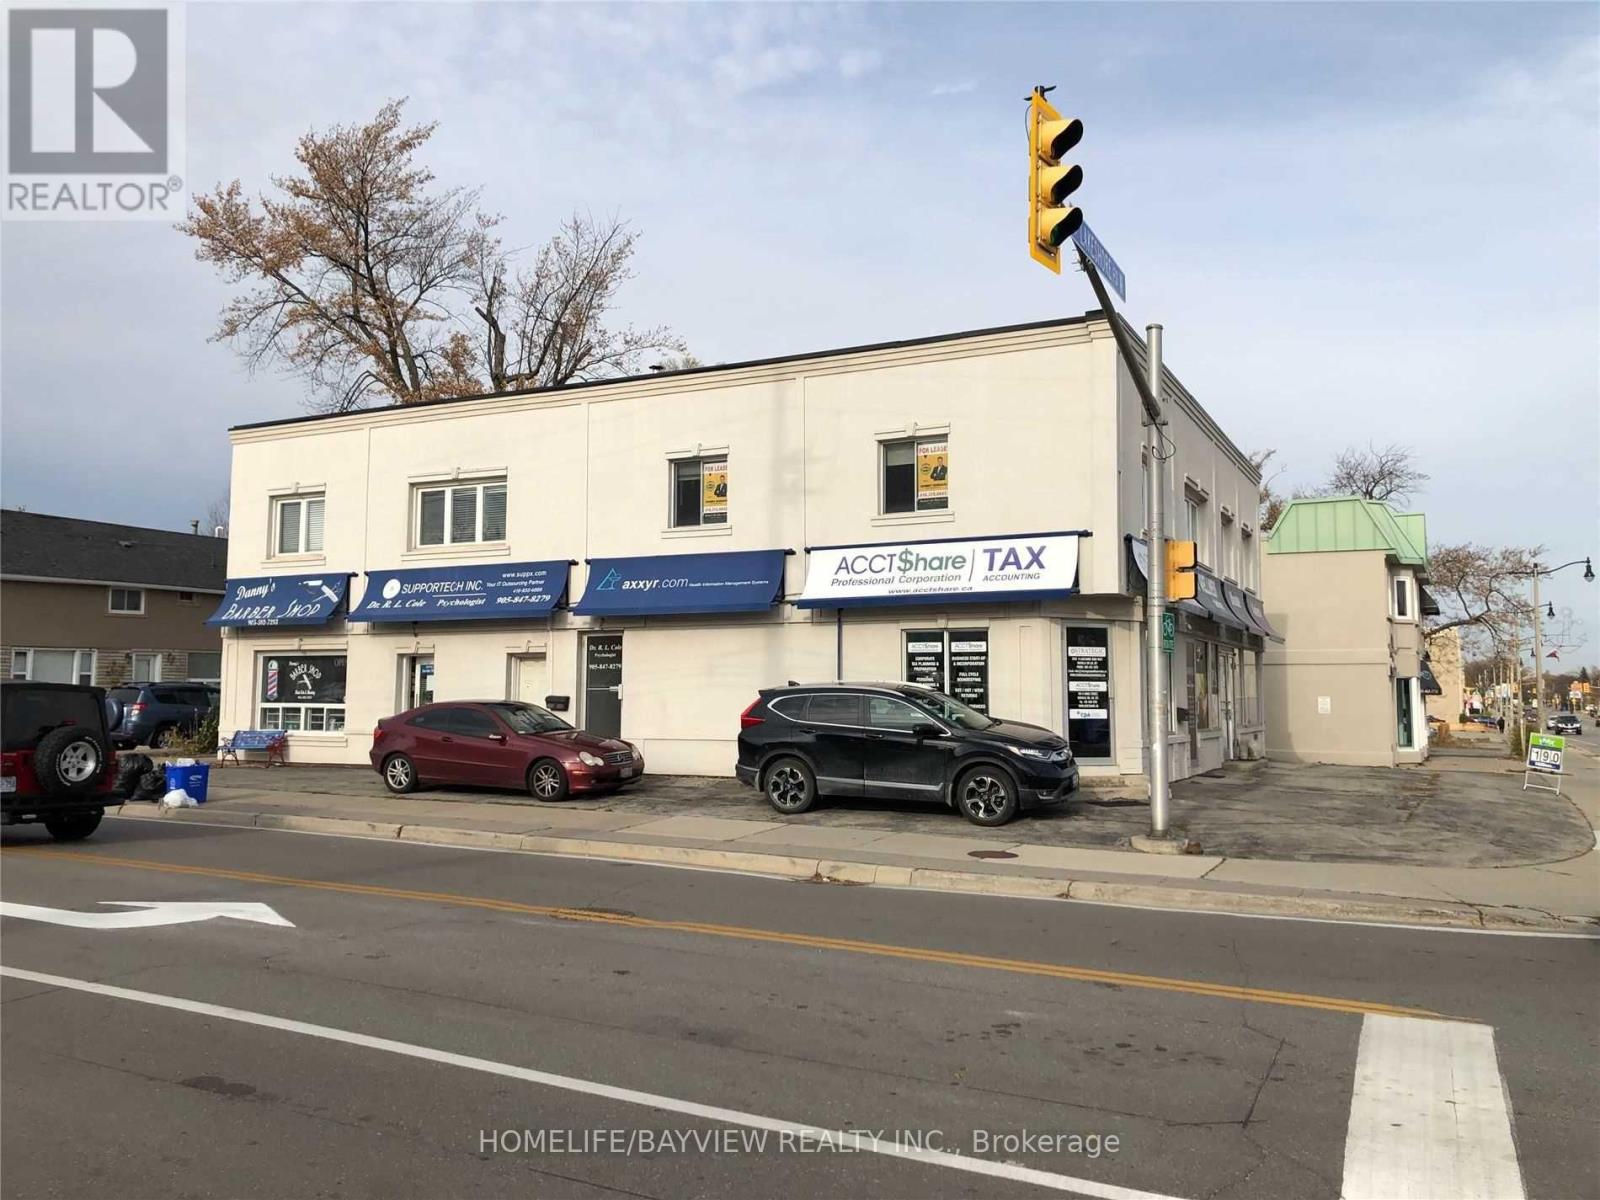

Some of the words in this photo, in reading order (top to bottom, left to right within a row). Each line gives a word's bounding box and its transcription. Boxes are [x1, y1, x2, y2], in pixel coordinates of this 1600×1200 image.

[704, 465, 714, 473] FOR
[983, 545, 1047, 572] TAX
[502, 570, 548, 578] www.suppx.com
[898, 573, 962, 585] Corporation
[982, 572, 1042, 582] ACCOUNTING
[401, 580, 464, 594] SUPPORTECH
[465, 580, 484, 592] INC.
[622, 577, 689, 592] axxyr.com
[830, 575, 896, 587] Professional
[235, 578, 276, 601] Danny's
[888, 586, 973, 595] www.acctshare.ca
[222, 603, 276, 620] BARBER
[278, 599, 321, 618] SHOP
[366, 600, 381, 610] Dr.
[382, 599, 392, 609] R.
[405, 598, 427, 608] Cole
[436, 598, 486, 608] Psychologist
